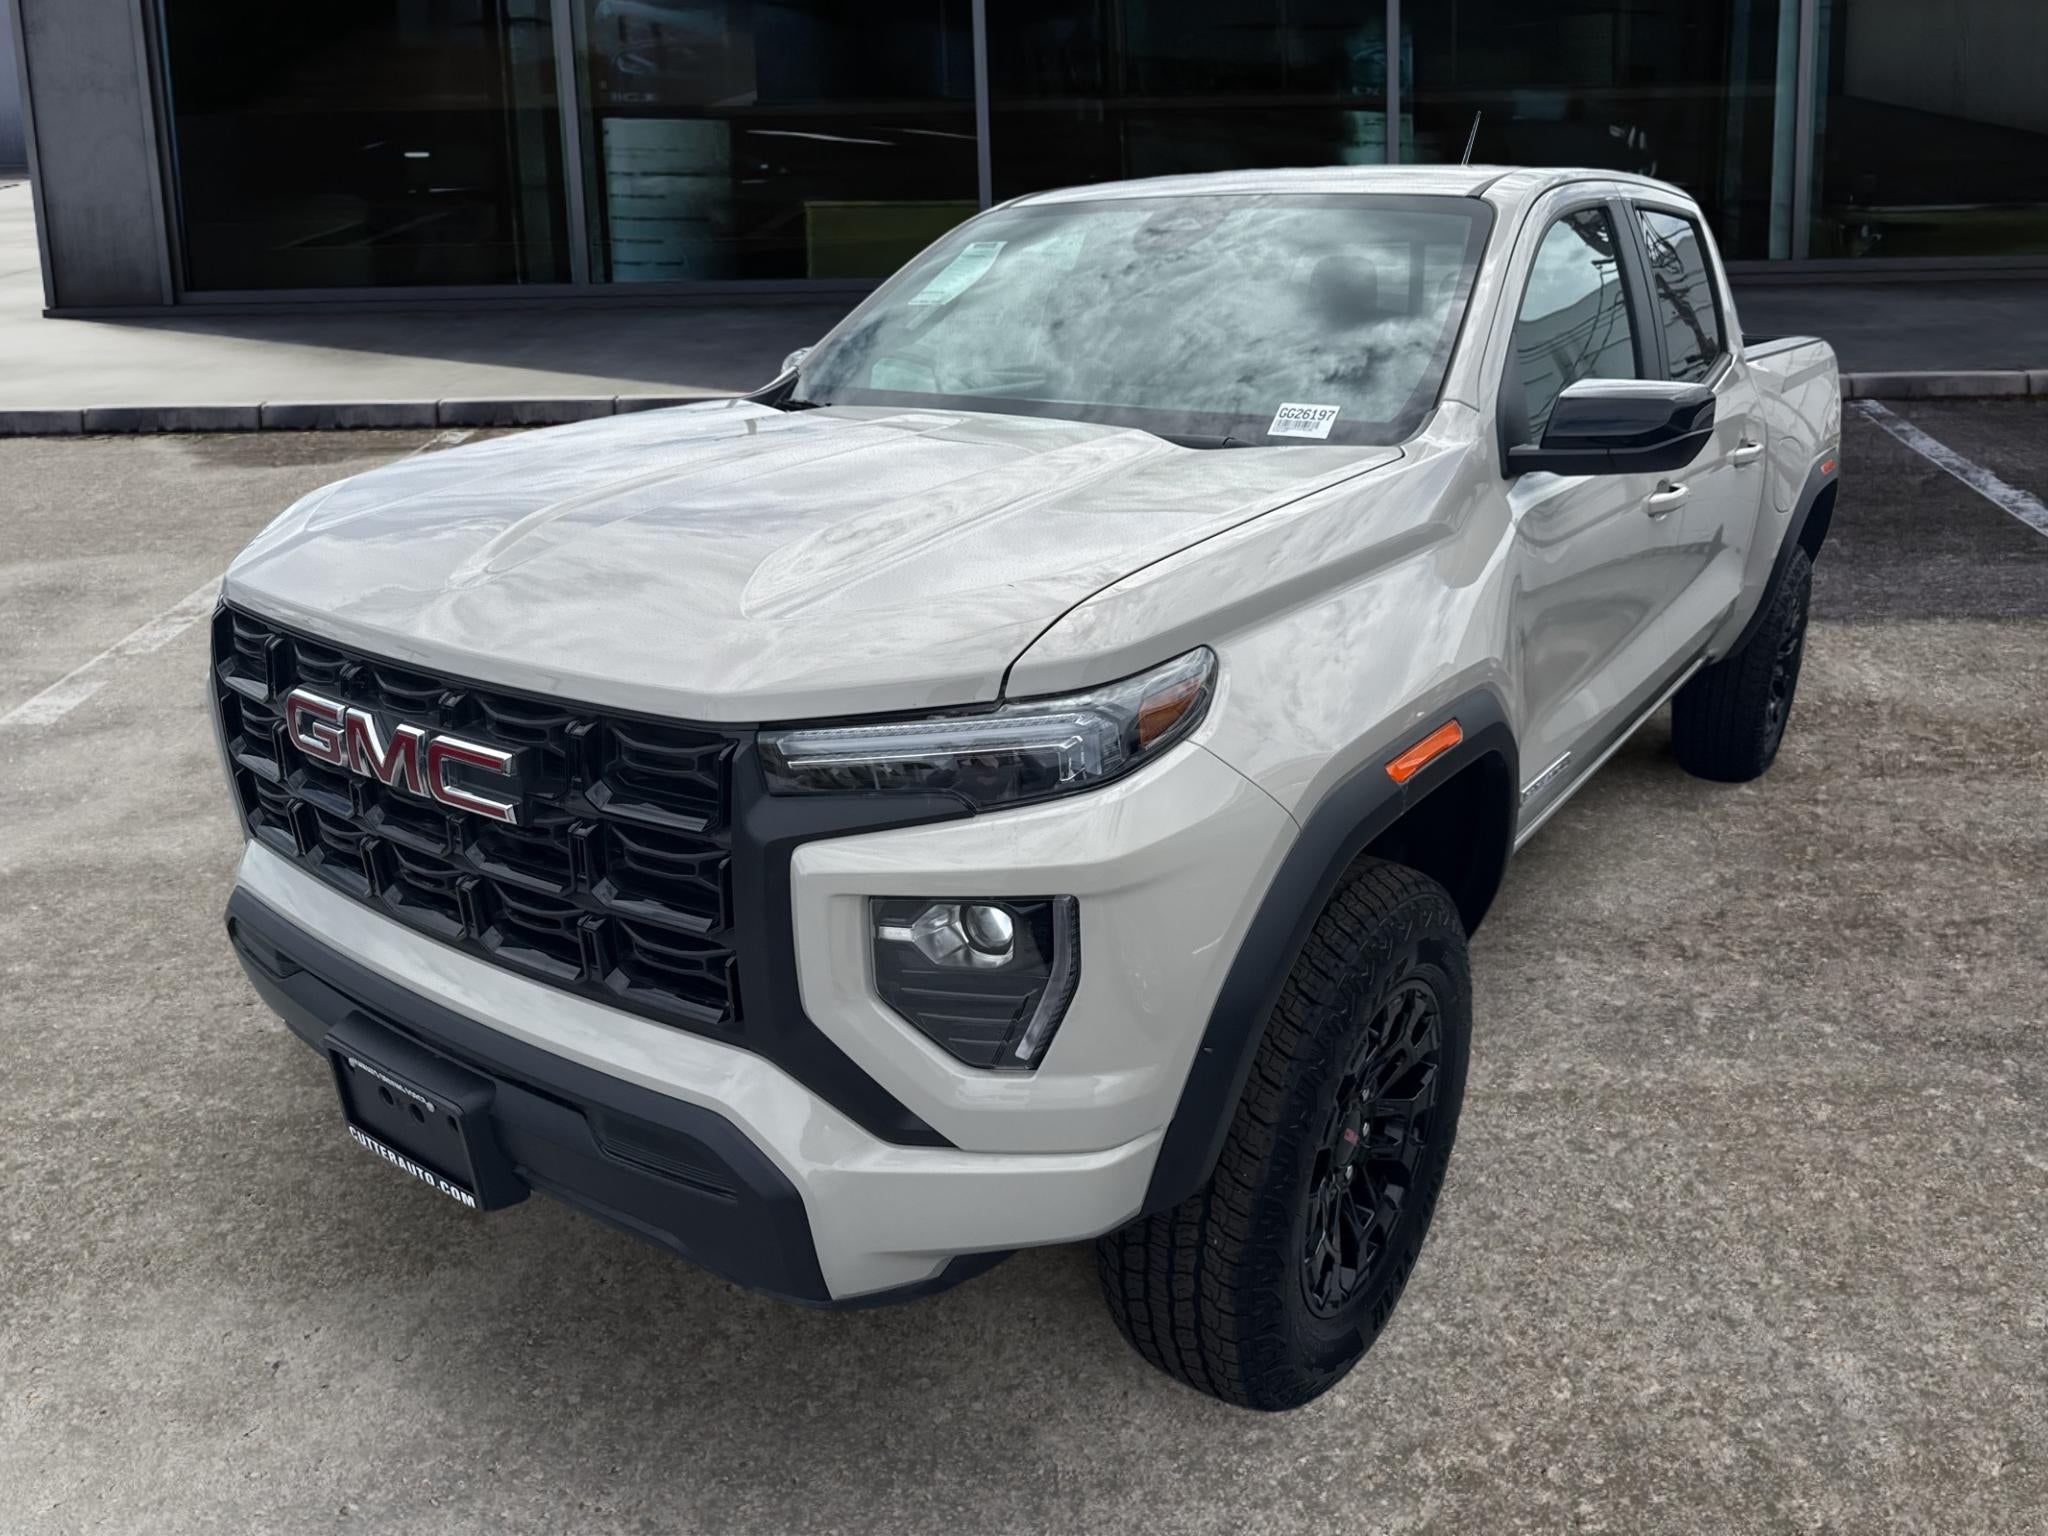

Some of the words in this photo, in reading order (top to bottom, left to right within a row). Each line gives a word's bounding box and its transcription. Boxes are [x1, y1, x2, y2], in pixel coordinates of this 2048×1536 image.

[1279, 407, 1336, 421] GG26197
[286, 688, 517, 824] GMC
[349, 1126, 476, 1208] CUTTERAUTO.COM
